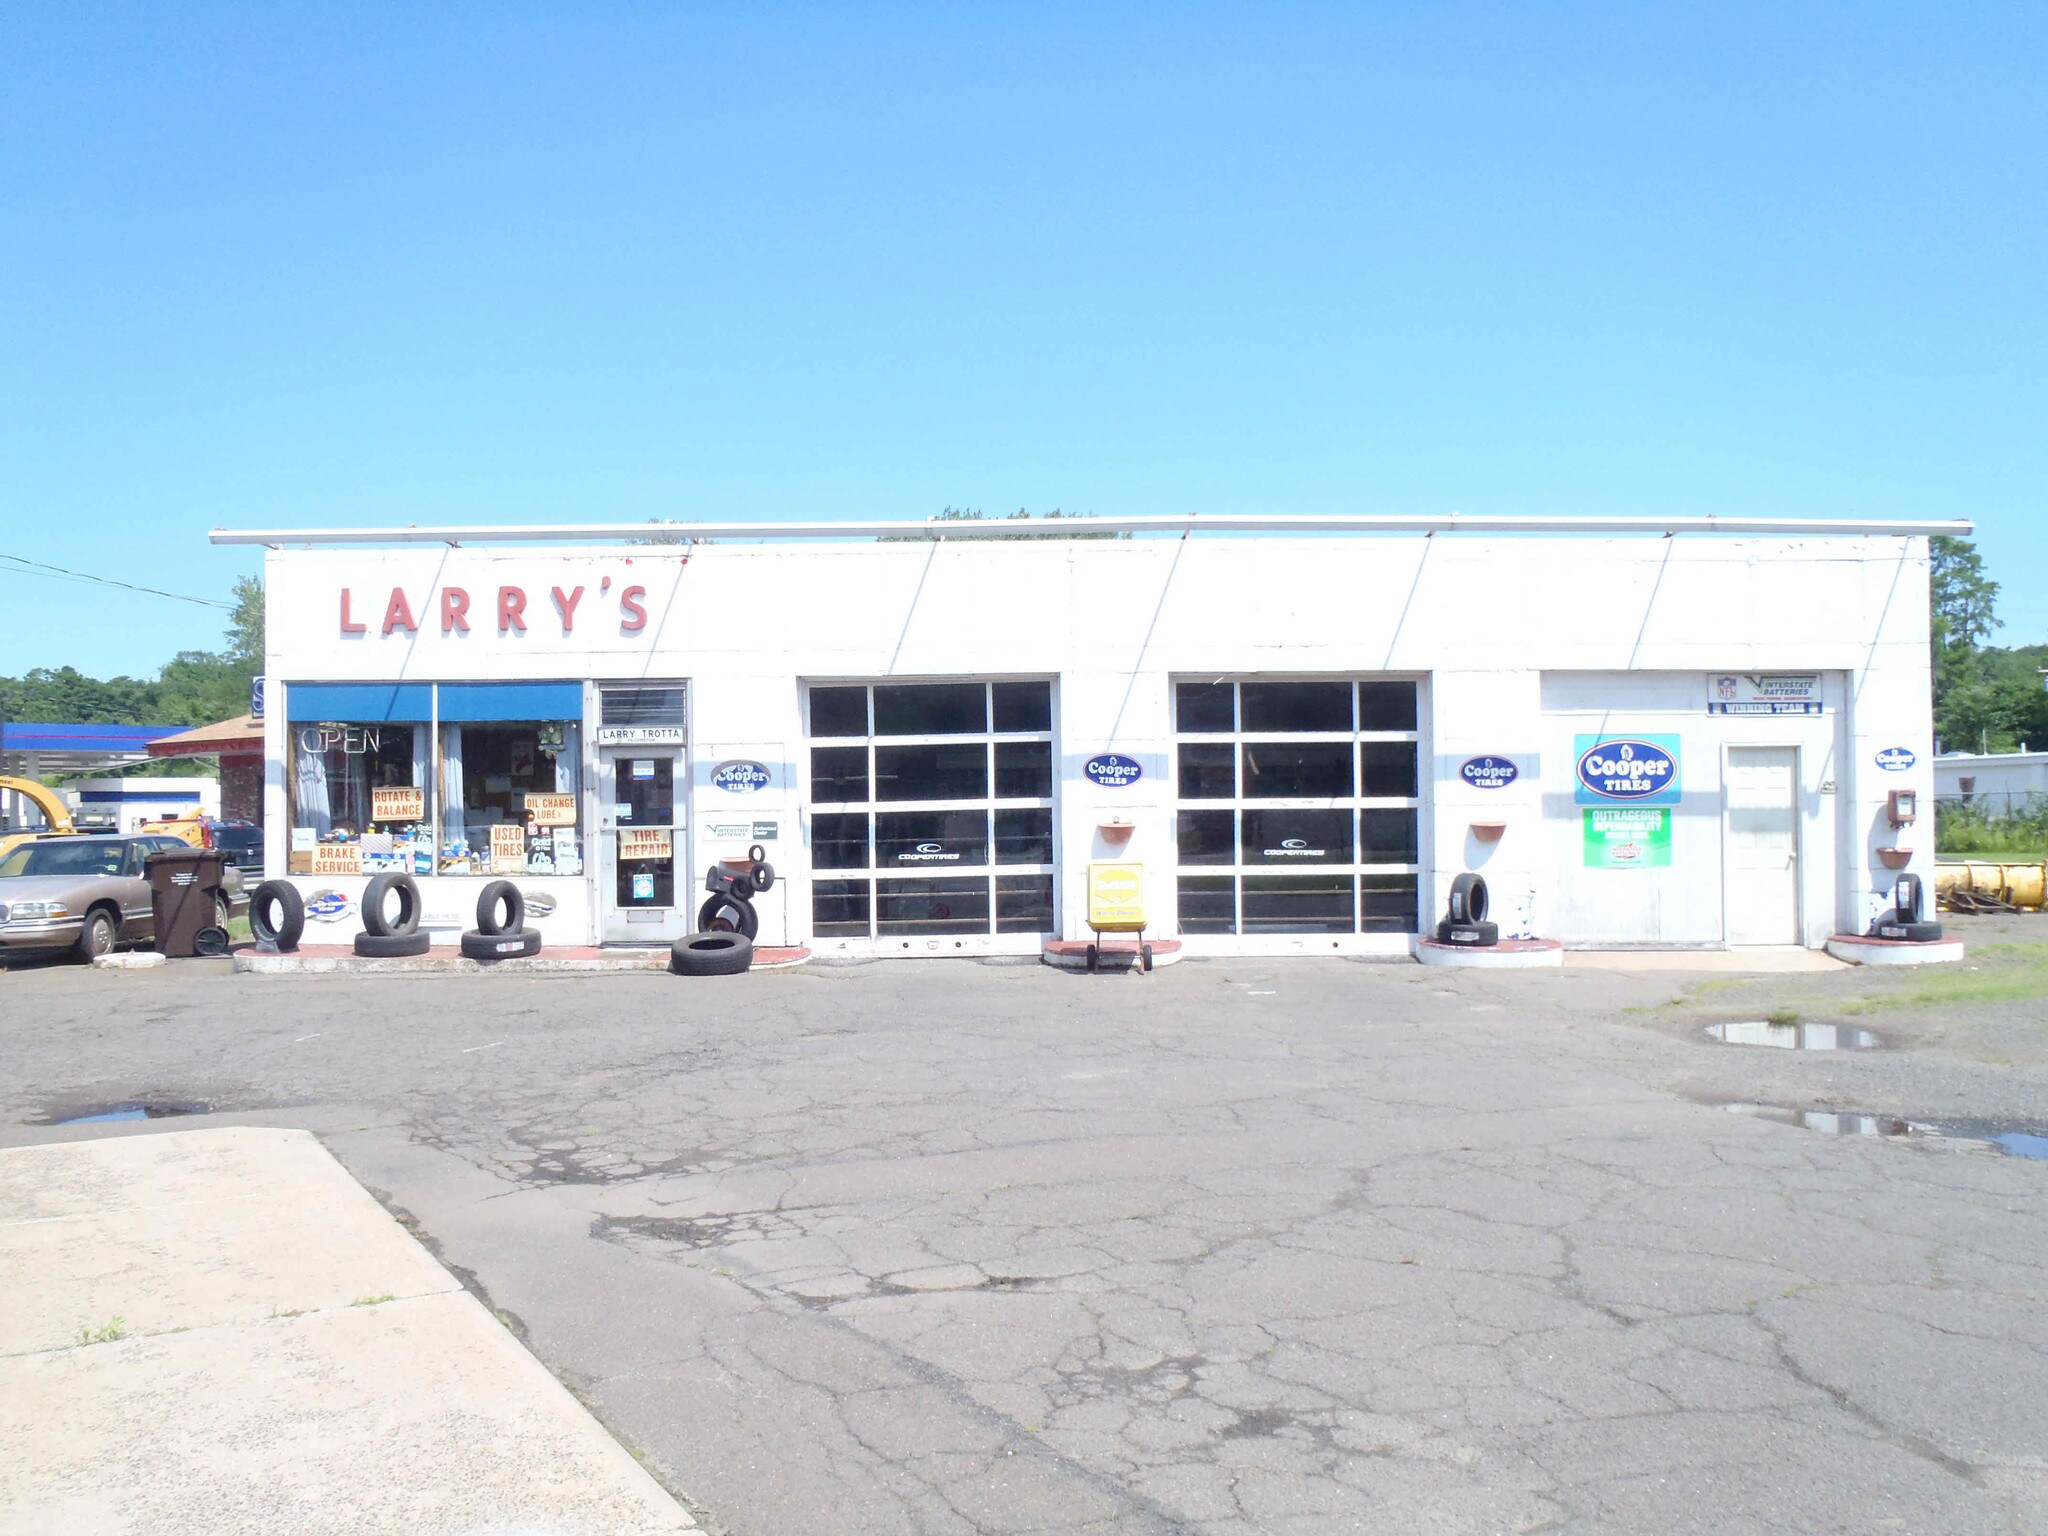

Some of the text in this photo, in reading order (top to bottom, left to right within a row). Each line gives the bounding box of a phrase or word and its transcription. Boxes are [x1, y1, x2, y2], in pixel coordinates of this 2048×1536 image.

[340, 576, 648, 633] LARRY'S
[1764, 681, 1813, 689] INTERSTATE
[1763, 688, 1809, 696] BATTERIES
[602, 728, 680, 739] LARRY TROTTA
[301, 727, 380, 754] OPEN
[1088, 762, 1138, 777] Cooper
[1464, 764, 1514, 779] Cooper
[1585, 755, 1669, 779] Cooper
[716, 770, 766, 783] Cooper
[1098, 776, 1128, 785] TIRES
[1474, 778, 1503, 786] TIRES
[1604, 779, 1651, 791] TIRES
[374, 790, 422, 802] ROTATE &
[526, 798, 575, 808] OIL CHANGE
[376, 804, 421, 816] BALANCE
[537, 810, 557, 819] LUBE
[1592, 810, 1661, 821] OUTRAGEOUS
[494, 827, 521, 841] USED
[631, 830, 660, 842] TIRE
[319, 847, 356, 859] BRAKE
[493, 843, 523, 857] TIRES
[625, 843, 669, 857] REPAIR
[315, 861, 361, 873] SERVICE
